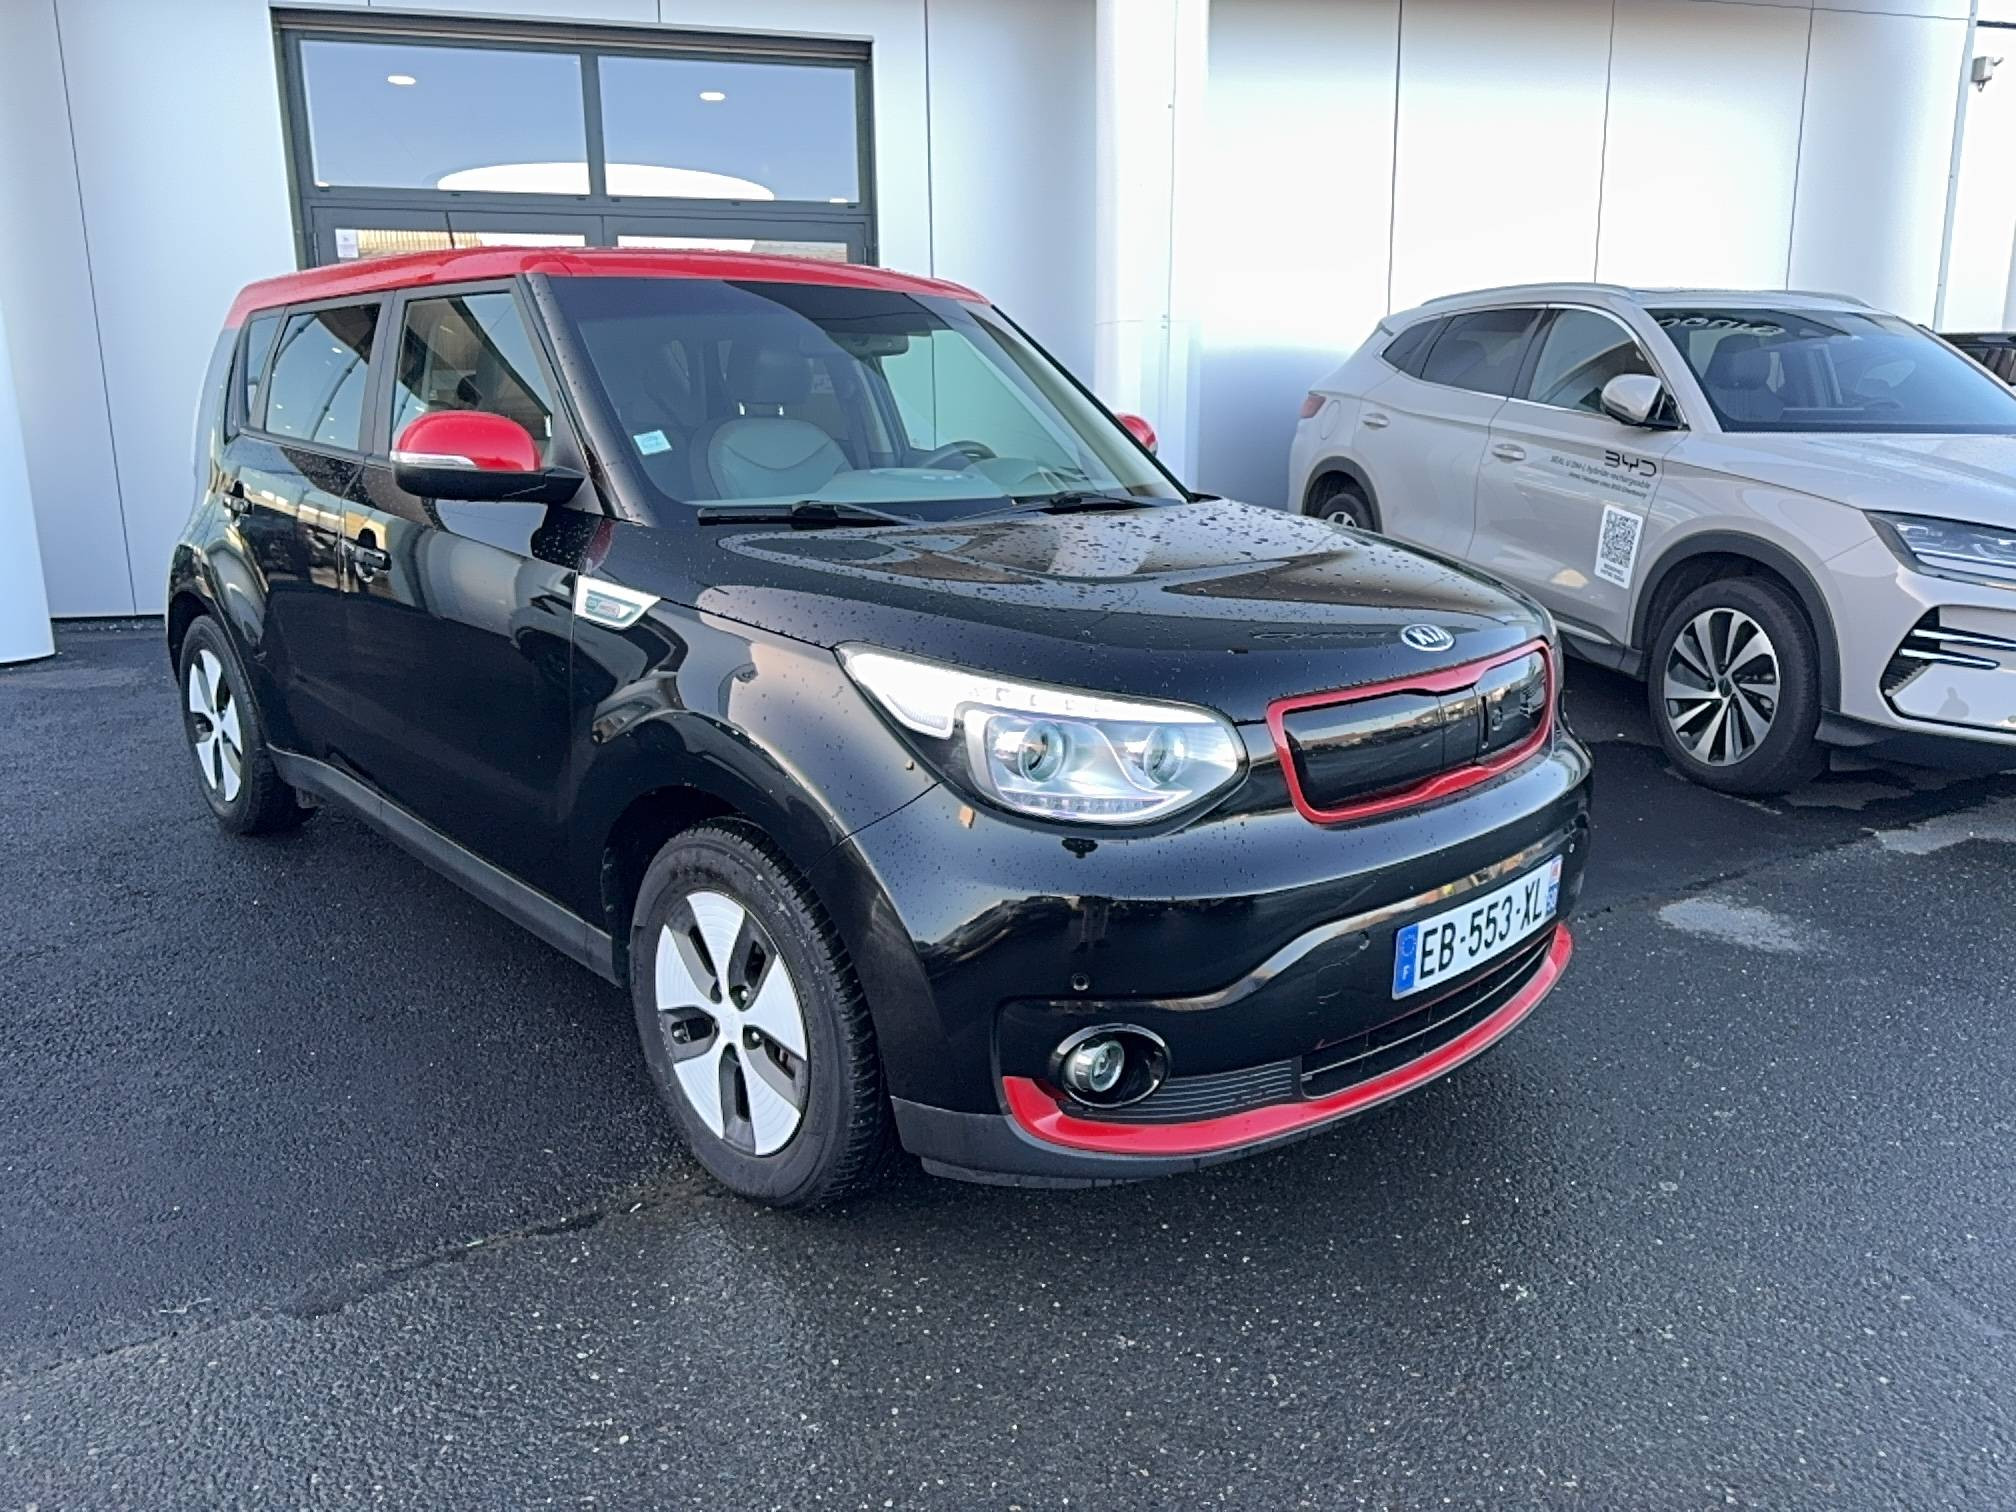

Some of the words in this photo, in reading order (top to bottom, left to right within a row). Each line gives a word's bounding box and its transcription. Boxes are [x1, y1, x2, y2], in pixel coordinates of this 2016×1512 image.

[1604, 449, 1657, 477] BYD
[1406, 626, 1451, 646] KIA
[1420, 878, 1542, 980] EB-553-XL
